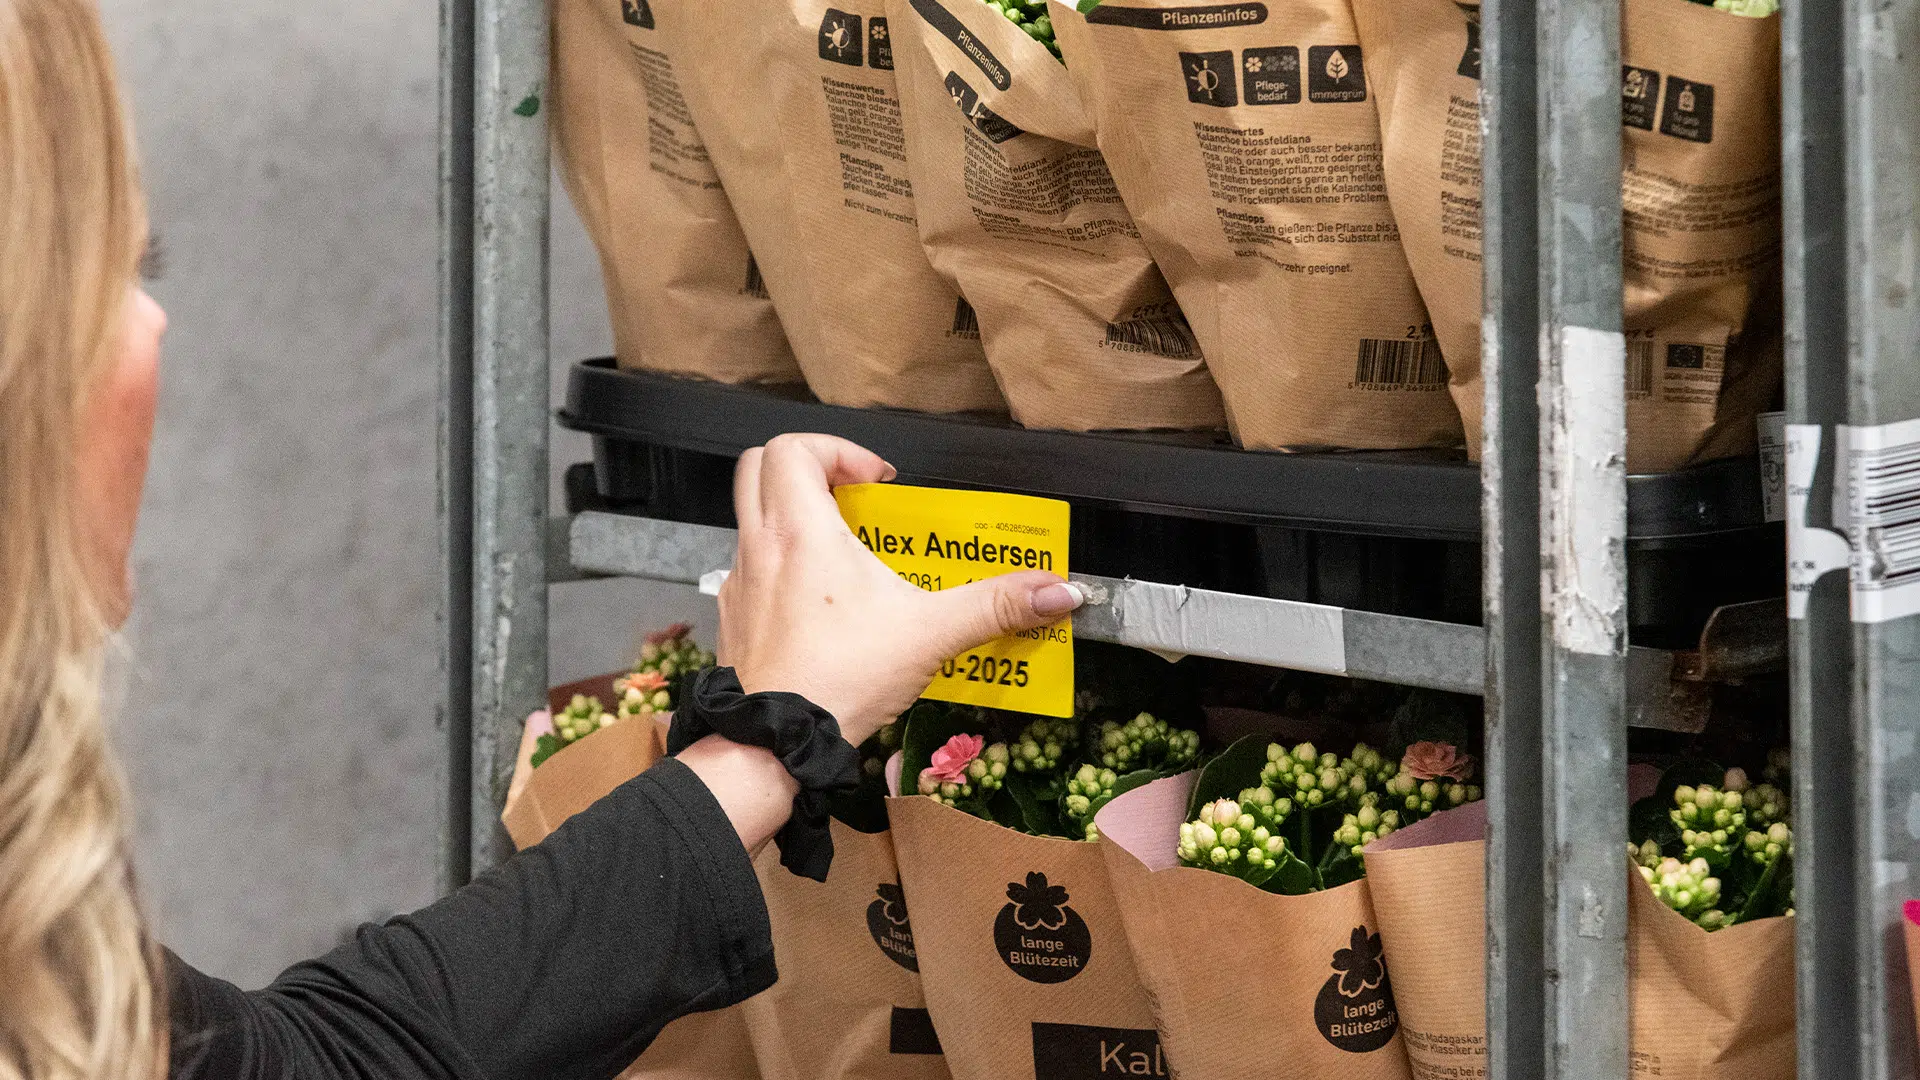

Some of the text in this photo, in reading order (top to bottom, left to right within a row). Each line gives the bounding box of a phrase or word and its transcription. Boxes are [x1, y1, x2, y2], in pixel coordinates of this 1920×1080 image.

[1162, 8, 1258, 26] Pflanzeninfos
[958, 30, 1004, 84] Pflanzeninfos
[821, 76, 885, 95] Wissenswertes
[823, 85, 865, 100] Kalanchoe
[1255, 80, 1289, 92] Pflege-
[825, 94, 867, 108] Kalanchoe
[868, 104, 887, 113] oder
[1257, 91, 1288, 101] bedarf
[1193, 121, 1265, 136] Wissenswertes
[1196, 131, 1312, 147] Kalanchoe blossfeldiana
[1199, 141, 1377, 156] Kalanchoe oder auch besser bekannt
[840, 152, 884, 172] Pflanztipps
[1065, 161, 1086, 171] oder
[1246, 157, 1284, 168] orange,
[1286, 154, 1313, 165] weiß,
[1314, 154, 1330, 164] rot
[1331, 153, 1355, 163] oder
[1011, 170, 1035, 181] auch
[1239, 164, 1326, 177] Einsteigerpflanze
[1327, 163, 1373, 174] geeignet,
[1250, 176, 1303, 186] besonders
[1304, 176, 1334, 186] gerne
[1336, 175, 1349, 183] an
[1069, 185, 1118, 198] Kalanchoe
[1220, 181, 1257, 195] Sommer
[1258, 186, 1290, 196] eignet
[1292, 184, 1312, 194] sich
[1314, 183, 1330, 194] die
[1331, 183, 1384, 193] Kalanchoe
[1238, 194, 1313, 205] Trockenphasen
[1315, 194, 1341, 204] ohne
[1216, 207, 1265, 224] Pflanztipps
[1278, 222, 1315, 236] gießen:
[1317, 222, 1334, 233] Die
[1335, 222, 1373, 233] Pflanze
[1375, 221, 1391, 233] bis
[1294, 233, 1315, 244] sich
[1317, 233, 1336, 243] das
[1337, 233, 1381, 243] Substrat
[1308, 263, 1353, 275] geeignet.
[1098, 340, 1104, 348] 5
[1347, 382, 1354, 390] 5
[995, 522, 1050, 537] 4052852966061
[858, 525, 1052, 571] Alex Andersen
[1021, 935, 1064, 952] lange
[1010, 951, 1080, 968] Blütezeit
[1343, 998, 1385, 1018] lange
[1330, 1011, 1396, 1037] Blütezeit
[1425, 1032, 1484, 1046] Madagaskar
[1430, 1043, 1474, 1055] Klassiker
[1100, 1040, 1165, 1077] Kal
[1460, 1066, 1475, 1077] bei
